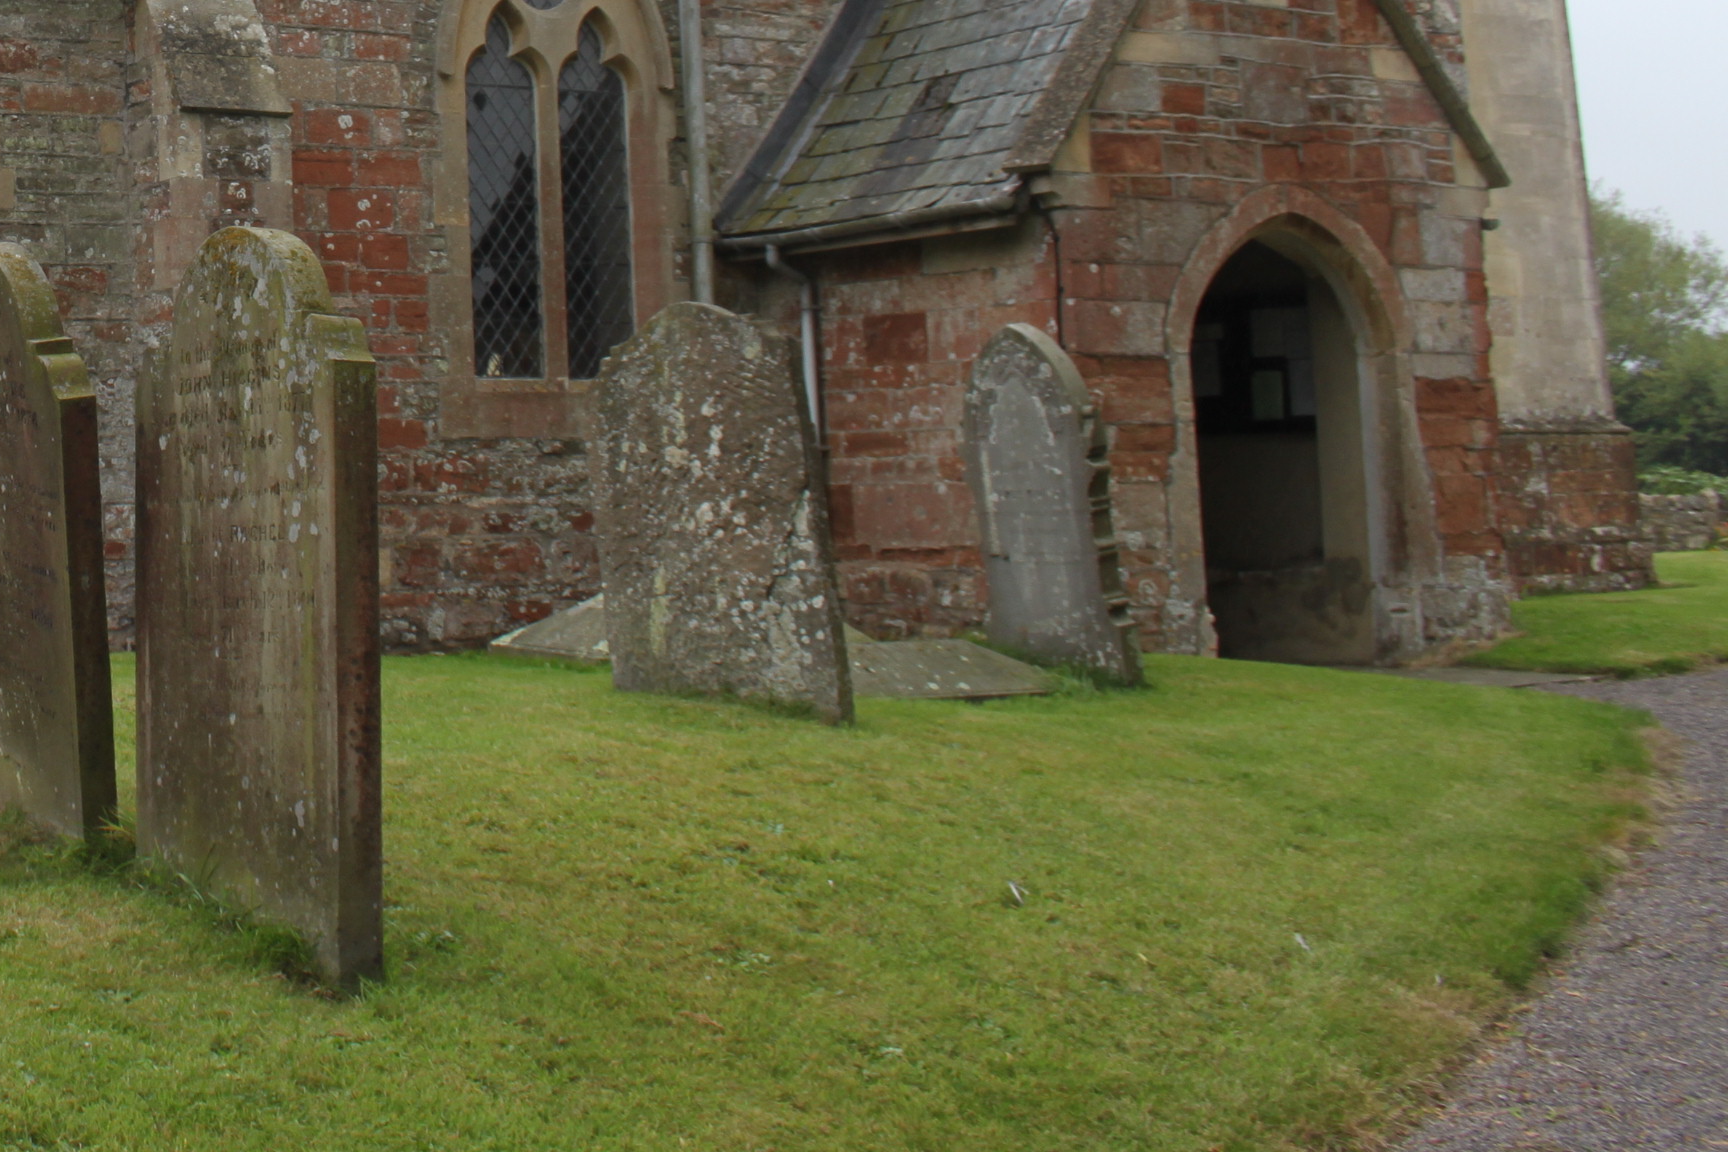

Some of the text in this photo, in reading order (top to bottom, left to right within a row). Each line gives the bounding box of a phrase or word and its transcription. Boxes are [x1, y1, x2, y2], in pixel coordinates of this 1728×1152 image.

[178, 363, 282, 397] JOHN HIGGINS
[229, 523, 286, 544] RACHEL
